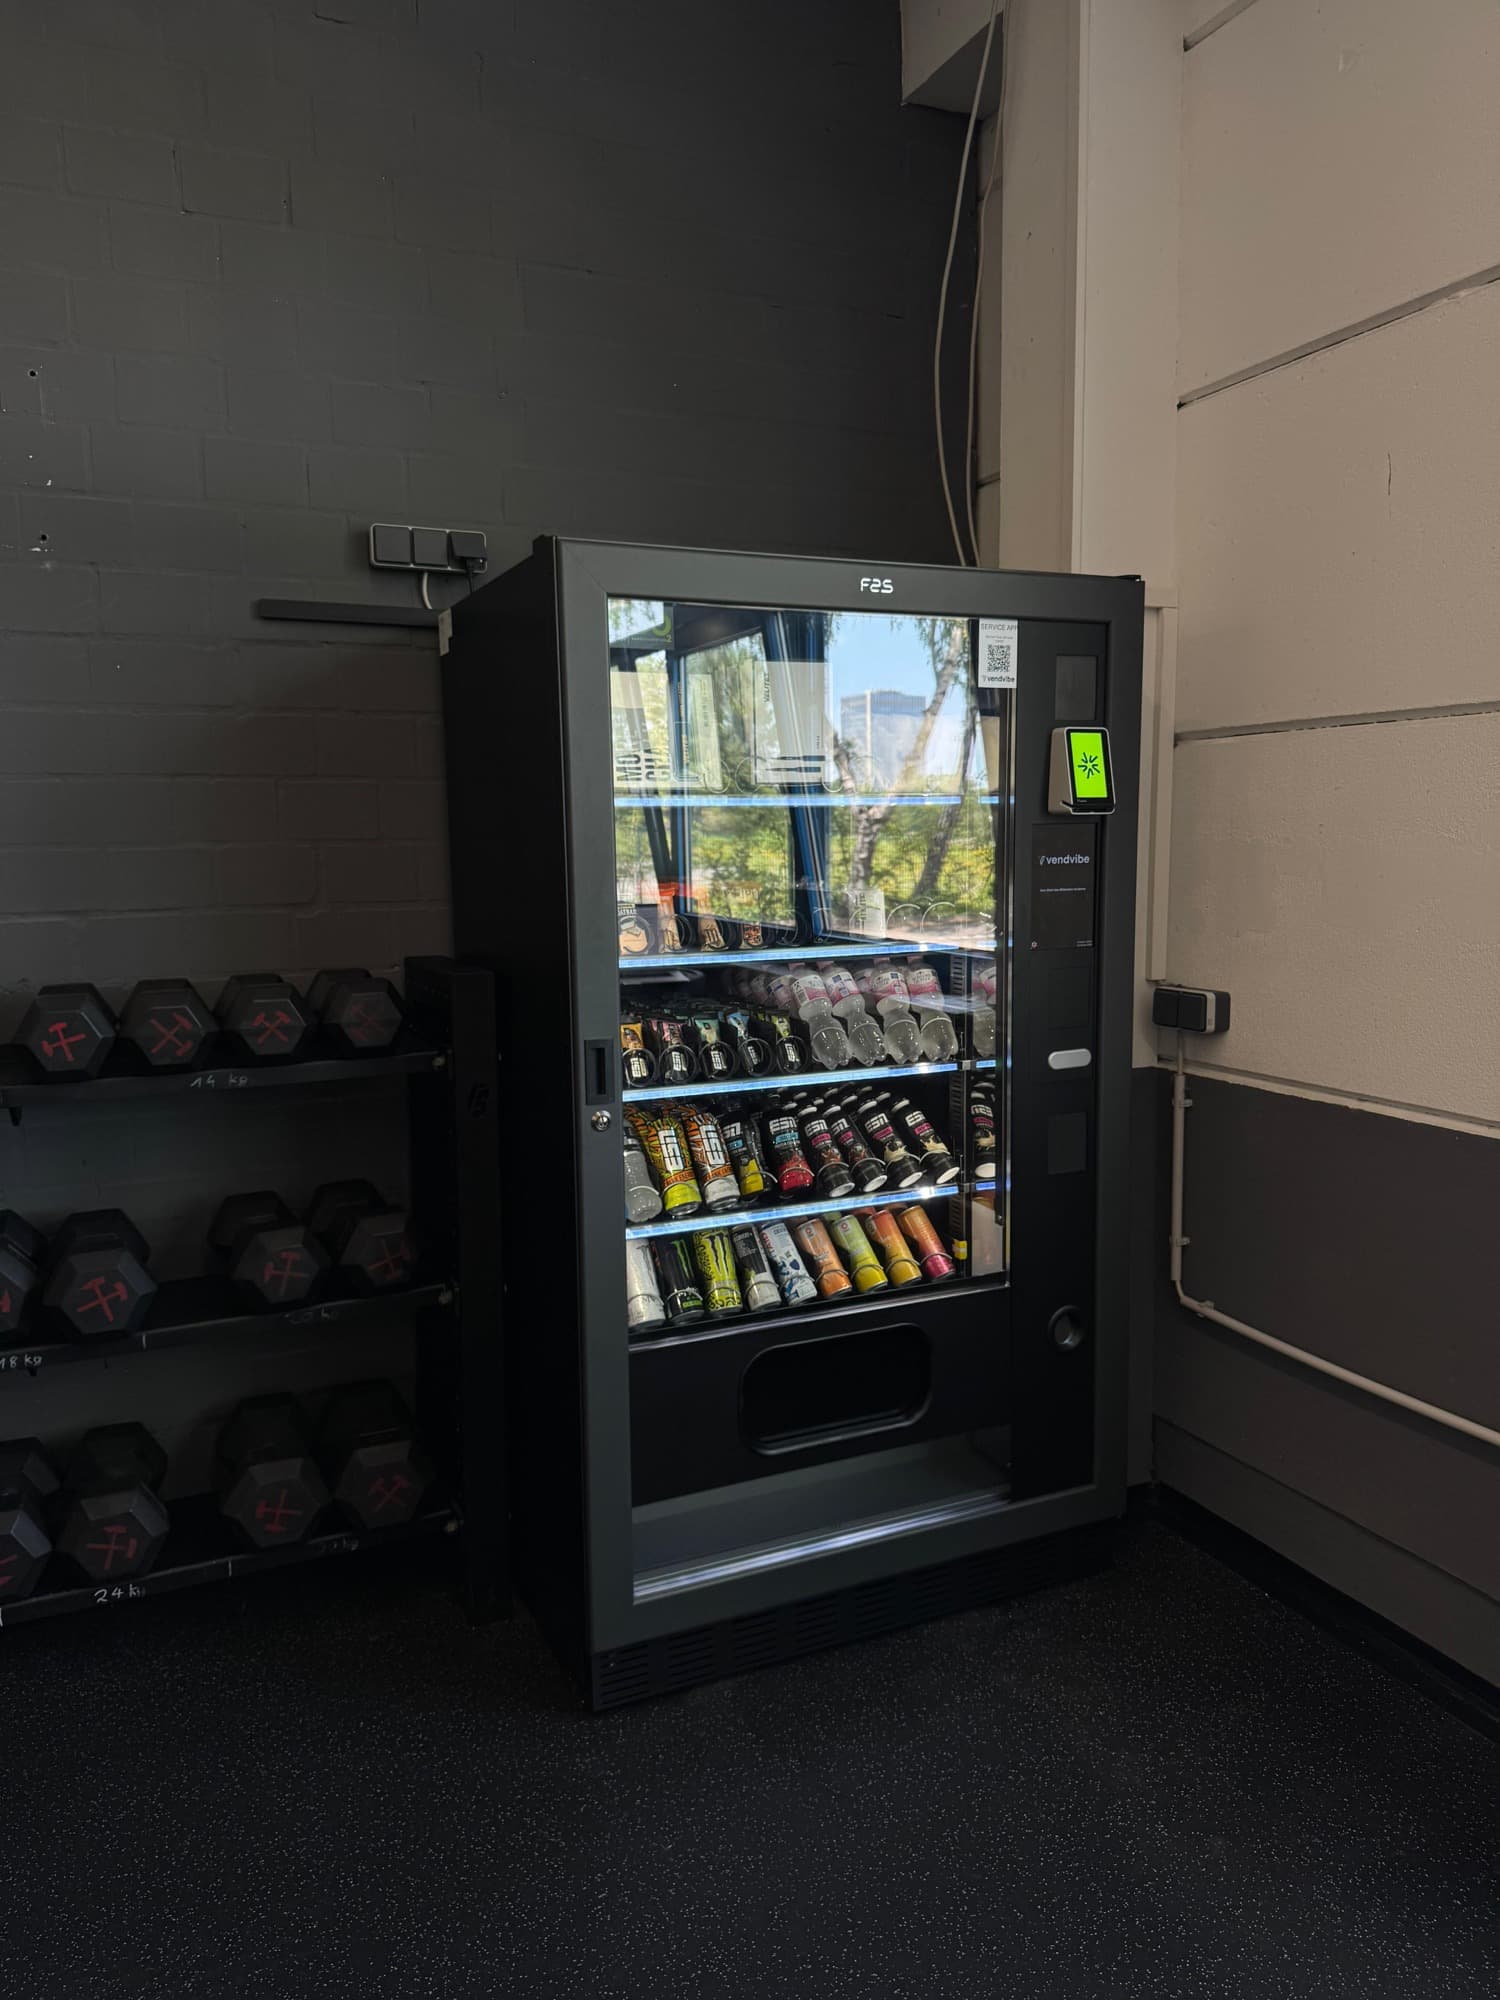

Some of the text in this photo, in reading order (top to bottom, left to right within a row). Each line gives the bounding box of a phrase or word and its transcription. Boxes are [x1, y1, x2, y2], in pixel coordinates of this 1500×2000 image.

[980, 623, 1006, 631] SERVICE
[987, 675, 1015, 683] vendvibe
[1046, 854, 1090, 865] vendvibe
[94, 1586, 125, 1603] 24
